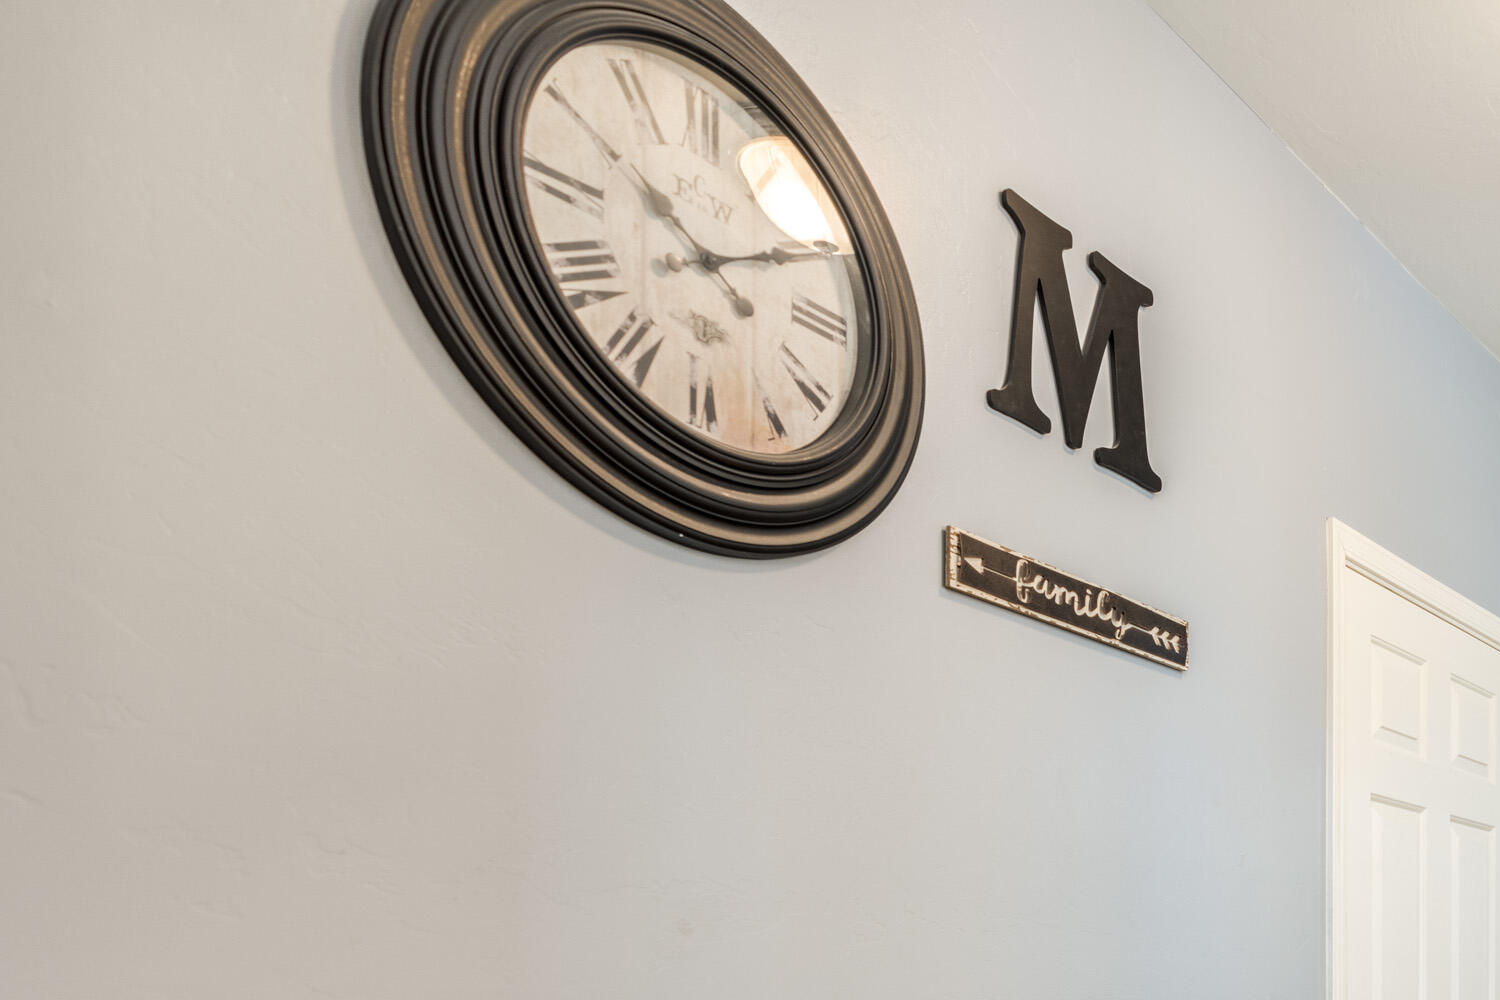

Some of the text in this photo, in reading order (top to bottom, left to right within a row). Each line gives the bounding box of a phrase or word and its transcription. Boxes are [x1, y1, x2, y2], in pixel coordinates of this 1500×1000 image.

[681, 78, 722, 168] XII
[986, 187, 1163, 493] M
[1015, 558, 1130, 640] family
